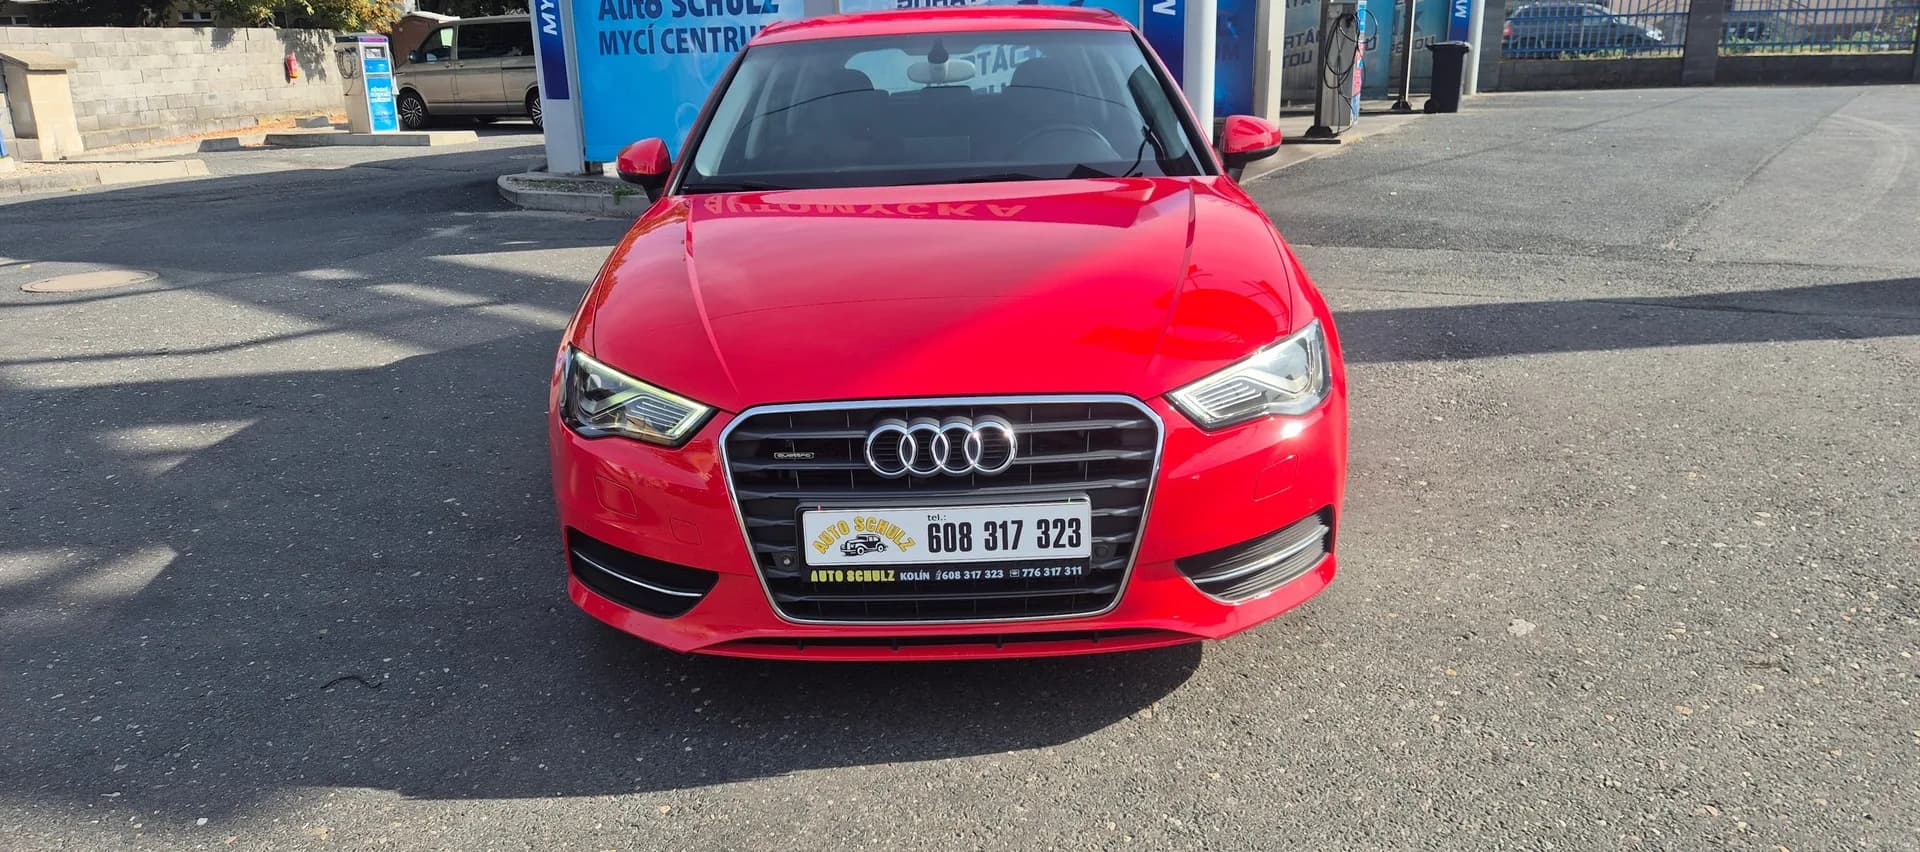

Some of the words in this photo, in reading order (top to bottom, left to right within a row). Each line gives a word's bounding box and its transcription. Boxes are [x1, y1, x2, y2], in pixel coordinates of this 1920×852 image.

[672, 0, 779, 18] SCHULZ
[599, 24, 655, 55] MYCÍ
[661, 25, 767, 54] CENTRU
[927, 513, 947, 522] tel.:
[812, 520, 850, 555] AUTO
[853, 515, 917, 553] SCHULZ
[927, 521, 973, 553] 608
[984, 519, 1024, 550] 317
[1036, 517, 1082, 549] 323
[810, 569, 844, 582] AUTO
[846, 569, 896, 582] SCHULZ
[900, 569, 930, 581] KOLÍN
[942, 572, 961, 580] 608
[963, 570, 982, 579] 317
[984, 569, 1004, 579] 323
[1022, 568, 1041, 578] 776
[1043, 567, 1062, 577] 317
[1063, 565, 1083, 576] 311
